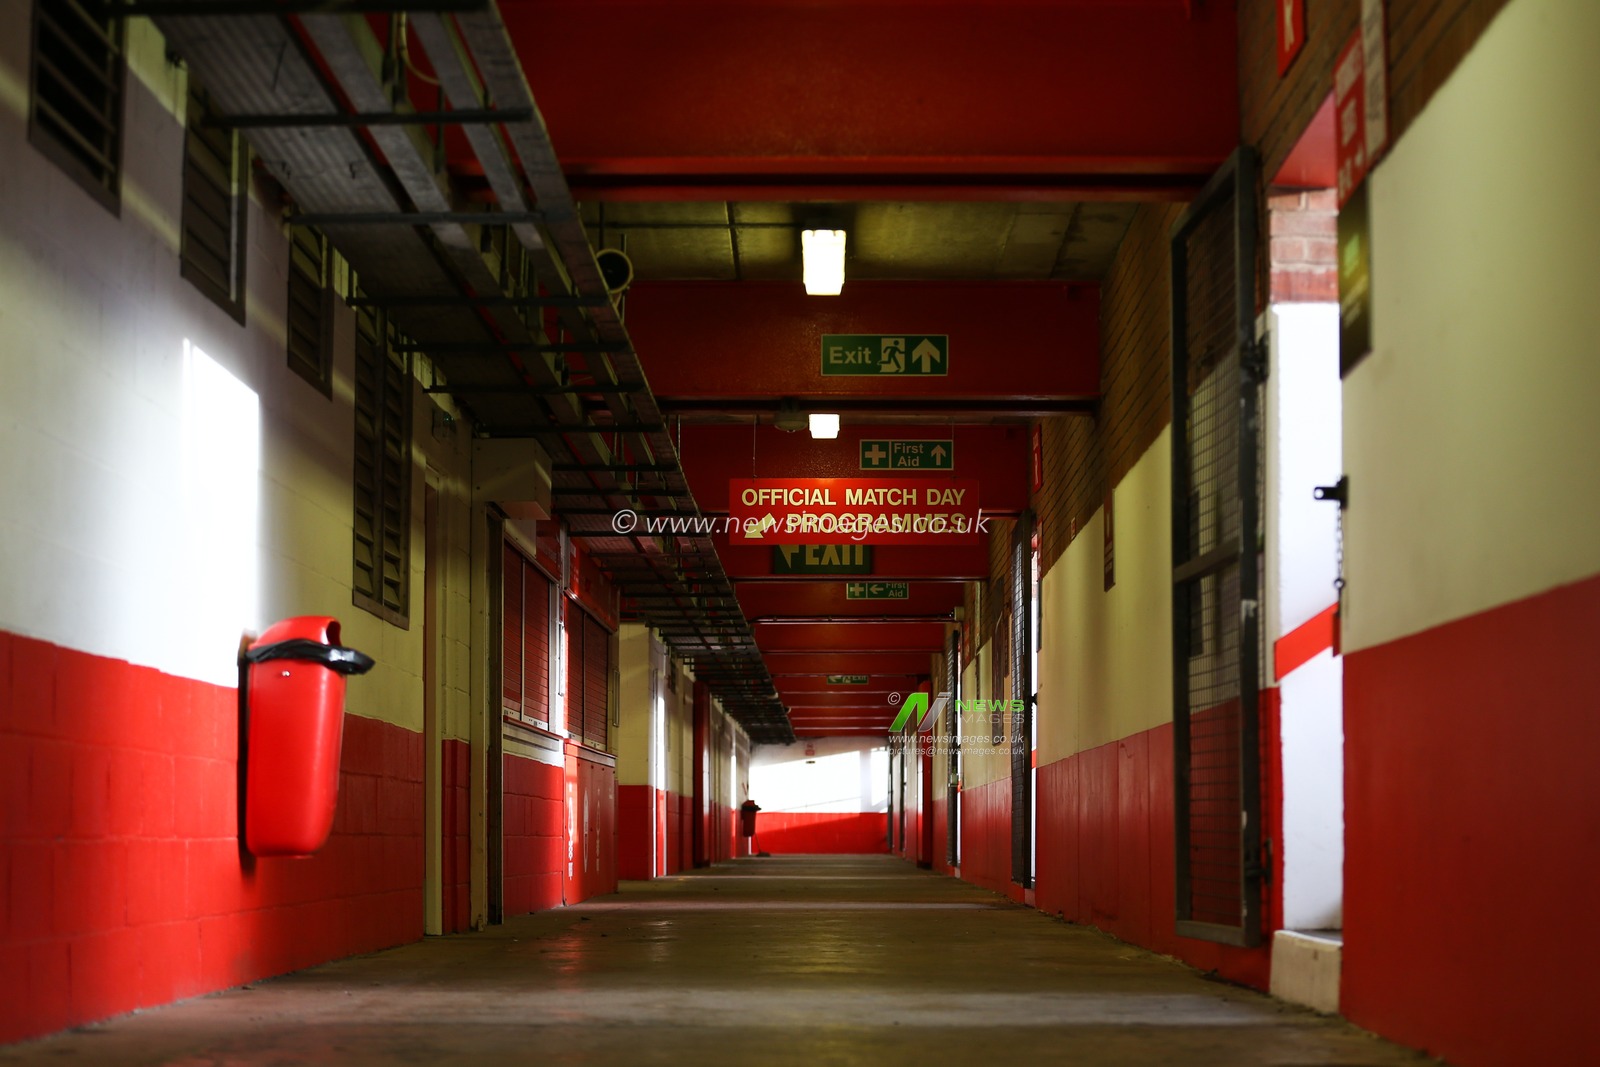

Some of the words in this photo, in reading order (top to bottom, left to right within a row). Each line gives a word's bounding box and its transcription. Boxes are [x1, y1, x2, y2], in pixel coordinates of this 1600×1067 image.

[830, 346, 872, 364] Exit
[894, 443, 924, 454] First
[897, 456, 920, 467] Aid
[741, 488, 837, 506] OFFICIAL
[845, 488, 917, 506] MATCH
[926, 488, 966, 506] DAY
[787, 512, 967, 533] PROGRAMMES
[888, 590, 903, 598] Aid
